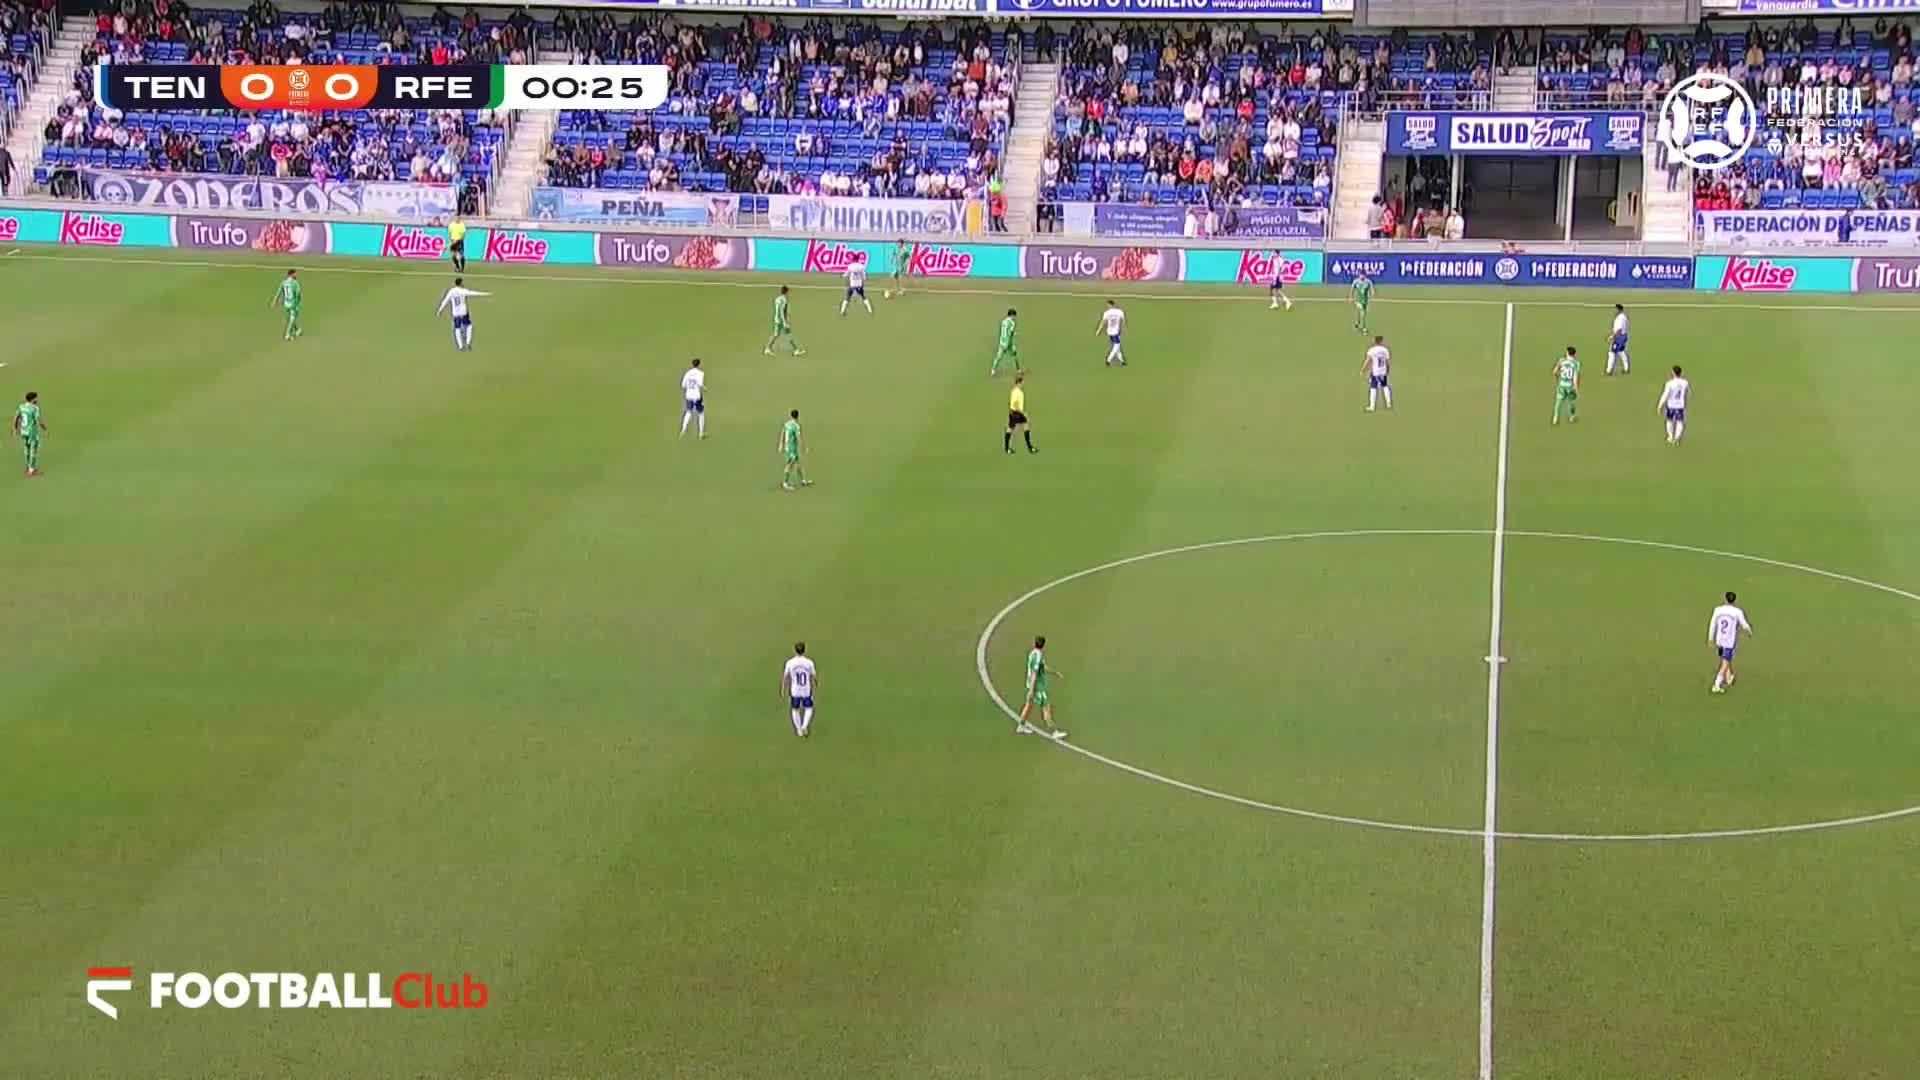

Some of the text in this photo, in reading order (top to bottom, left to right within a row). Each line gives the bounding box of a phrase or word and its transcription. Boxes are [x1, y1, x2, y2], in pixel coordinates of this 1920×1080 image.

[1457, 122, 1529, 144] SALUD
[600, 196, 665, 217] PEÑA
[60, 210, 124, 244] Kalise
[190, 220, 248, 246] Trufo
[1235, 225, 1309, 236] ANQUIAZUL
[1713, 212, 1820, 233] FEDERACIÓN
[381, 223, 446, 257] Kalise
[484, 229, 548, 262] Kalise
[613, 238, 670, 263] Trufo
[804, 238, 868, 273] Kalise
[908, 242, 973, 277] Kalise
[1039, 250, 1098, 275] Trufo
[1236, 249, 1305, 284] Kalse
[1342, 260, 1385, 271] VERSUS
[1414, 259, 1483, 277] FEDERACIÓN
[1545, 260, 1616, 279] FEDERACIÓN
[1643, 264, 1688, 274] VERSUS
[1720, 256, 1796, 291] Kalise
[1560, 366, 1573, 379] 20
[796, 671, 807, 687] 10
